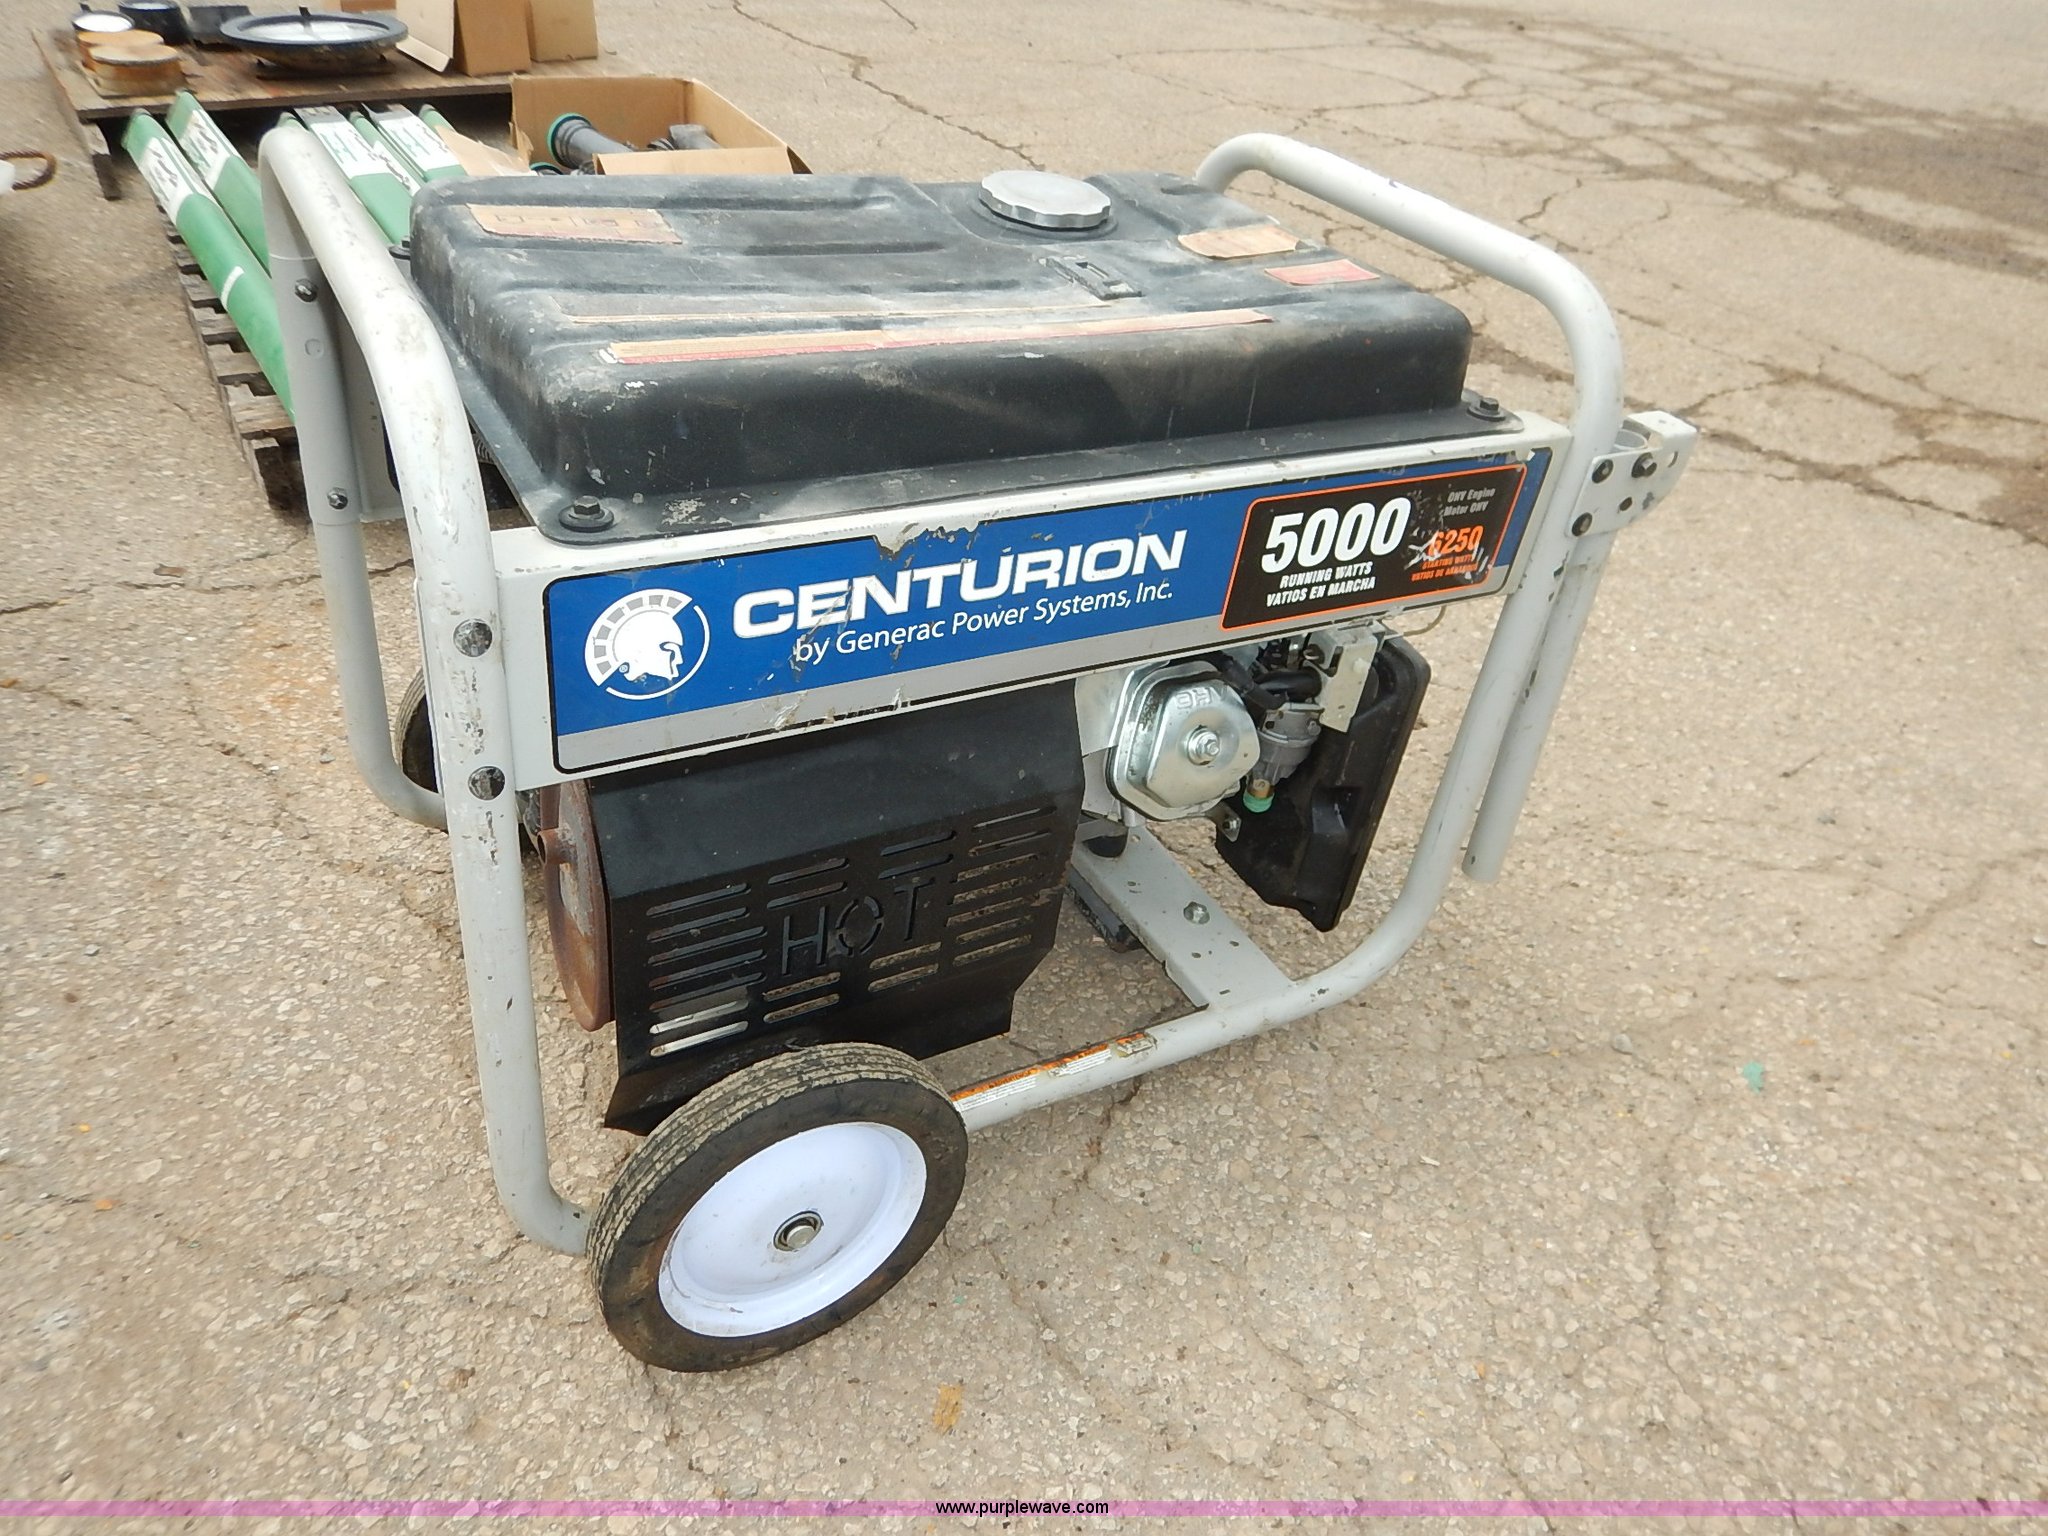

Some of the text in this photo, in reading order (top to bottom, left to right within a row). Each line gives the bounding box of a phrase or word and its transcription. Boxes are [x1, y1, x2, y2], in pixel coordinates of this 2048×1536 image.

[1443, 504, 1469, 516] Motor
[1467, 487, 1496, 501] Engine
[1261, 497, 1411, 573] 5000
[1428, 525, 1484, 558] 6250
[733, 529, 1188, 639] CENTURION
[1266, 576, 1376, 607] VATIOS EN MARCHA
[1279, 561, 1374, 589] RUNNING WATTS
[796, 582, 1173, 665] by Generac Power Systems, Inc.
[781, 876, 936, 976] HOT
